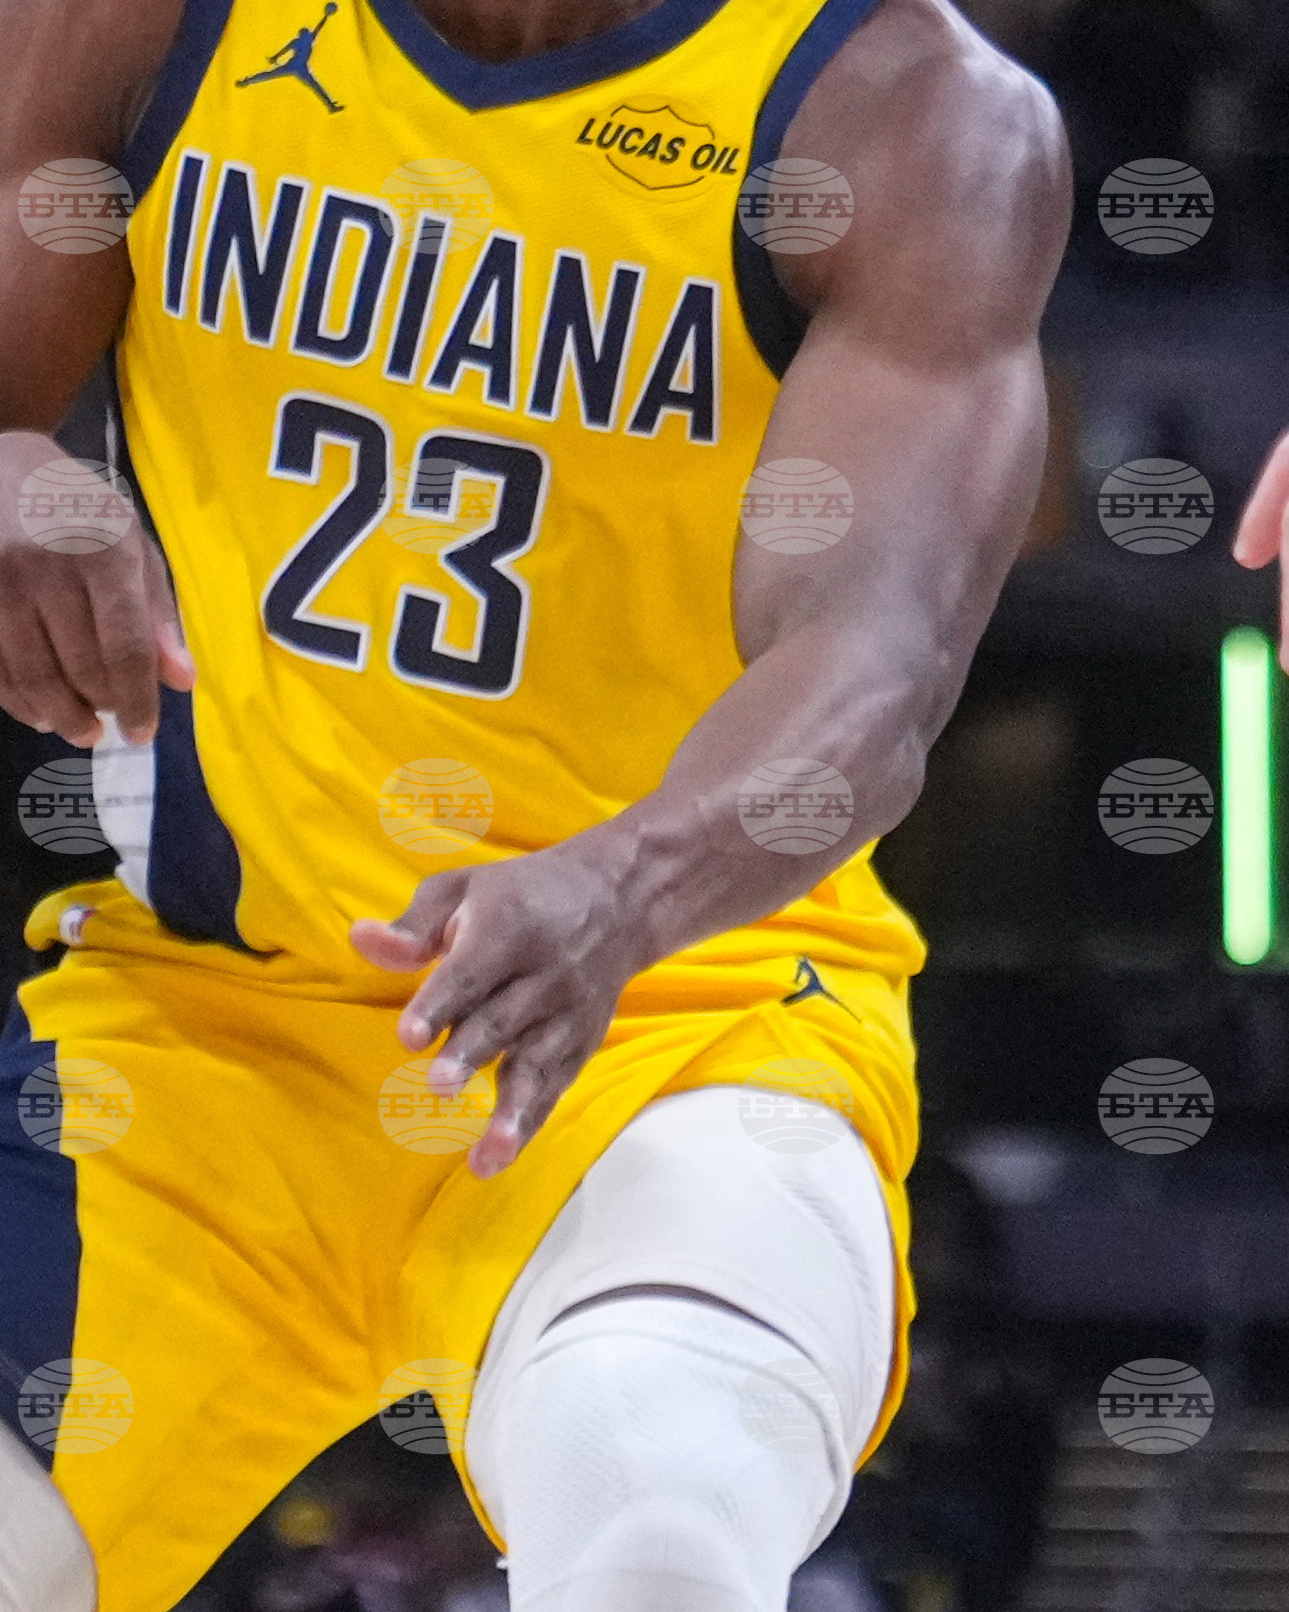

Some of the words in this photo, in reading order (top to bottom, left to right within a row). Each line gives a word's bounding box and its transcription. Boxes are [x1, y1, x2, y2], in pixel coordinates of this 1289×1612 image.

[574, 118, 686, 165] LUCAS
[690, 143, 740, 175] OIL
[162, 147, 721, 447] INDIANA
[261, 389, 552, 702] 23
